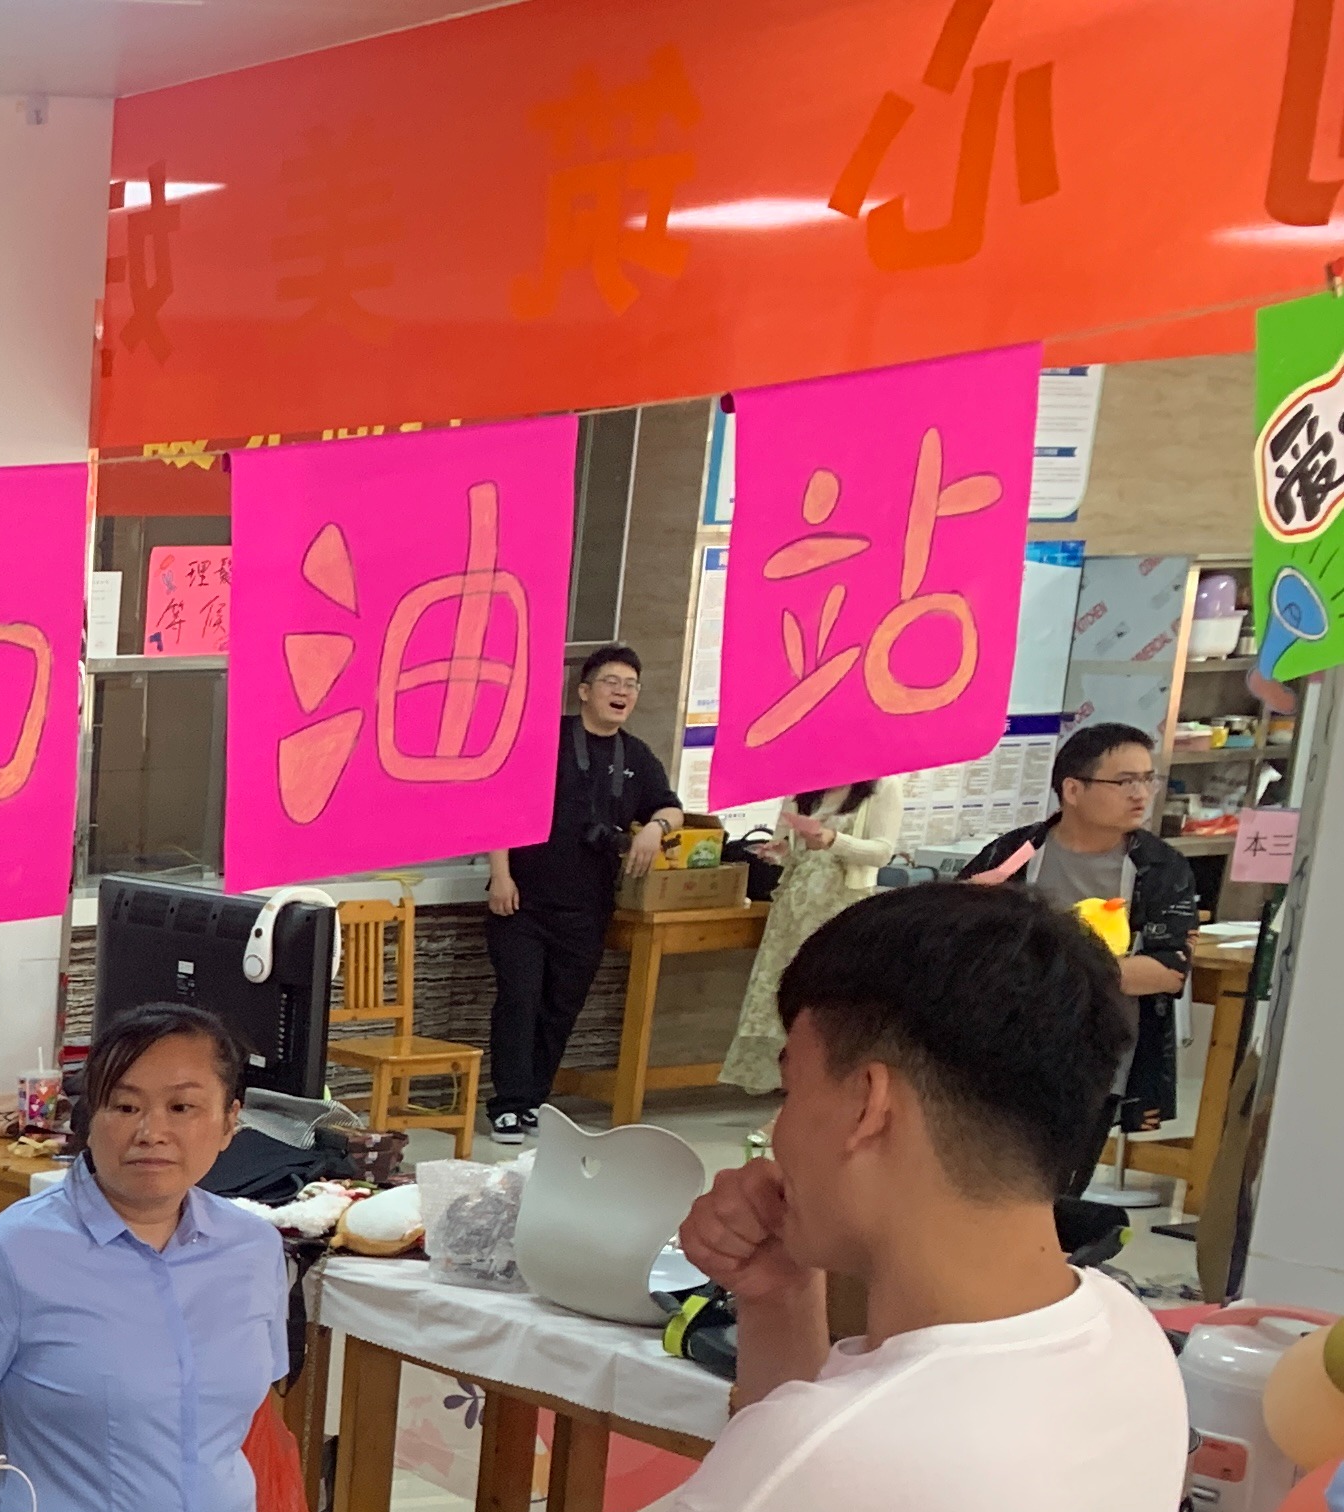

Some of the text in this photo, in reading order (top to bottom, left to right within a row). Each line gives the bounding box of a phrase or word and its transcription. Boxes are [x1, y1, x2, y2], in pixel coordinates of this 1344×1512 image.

[1269, 402, 1344, 525] 爱
[276, 479, 530, 824] 油
[744, 425, 1004, 748] 站
[1243, 831, 1294, 858] 本三
